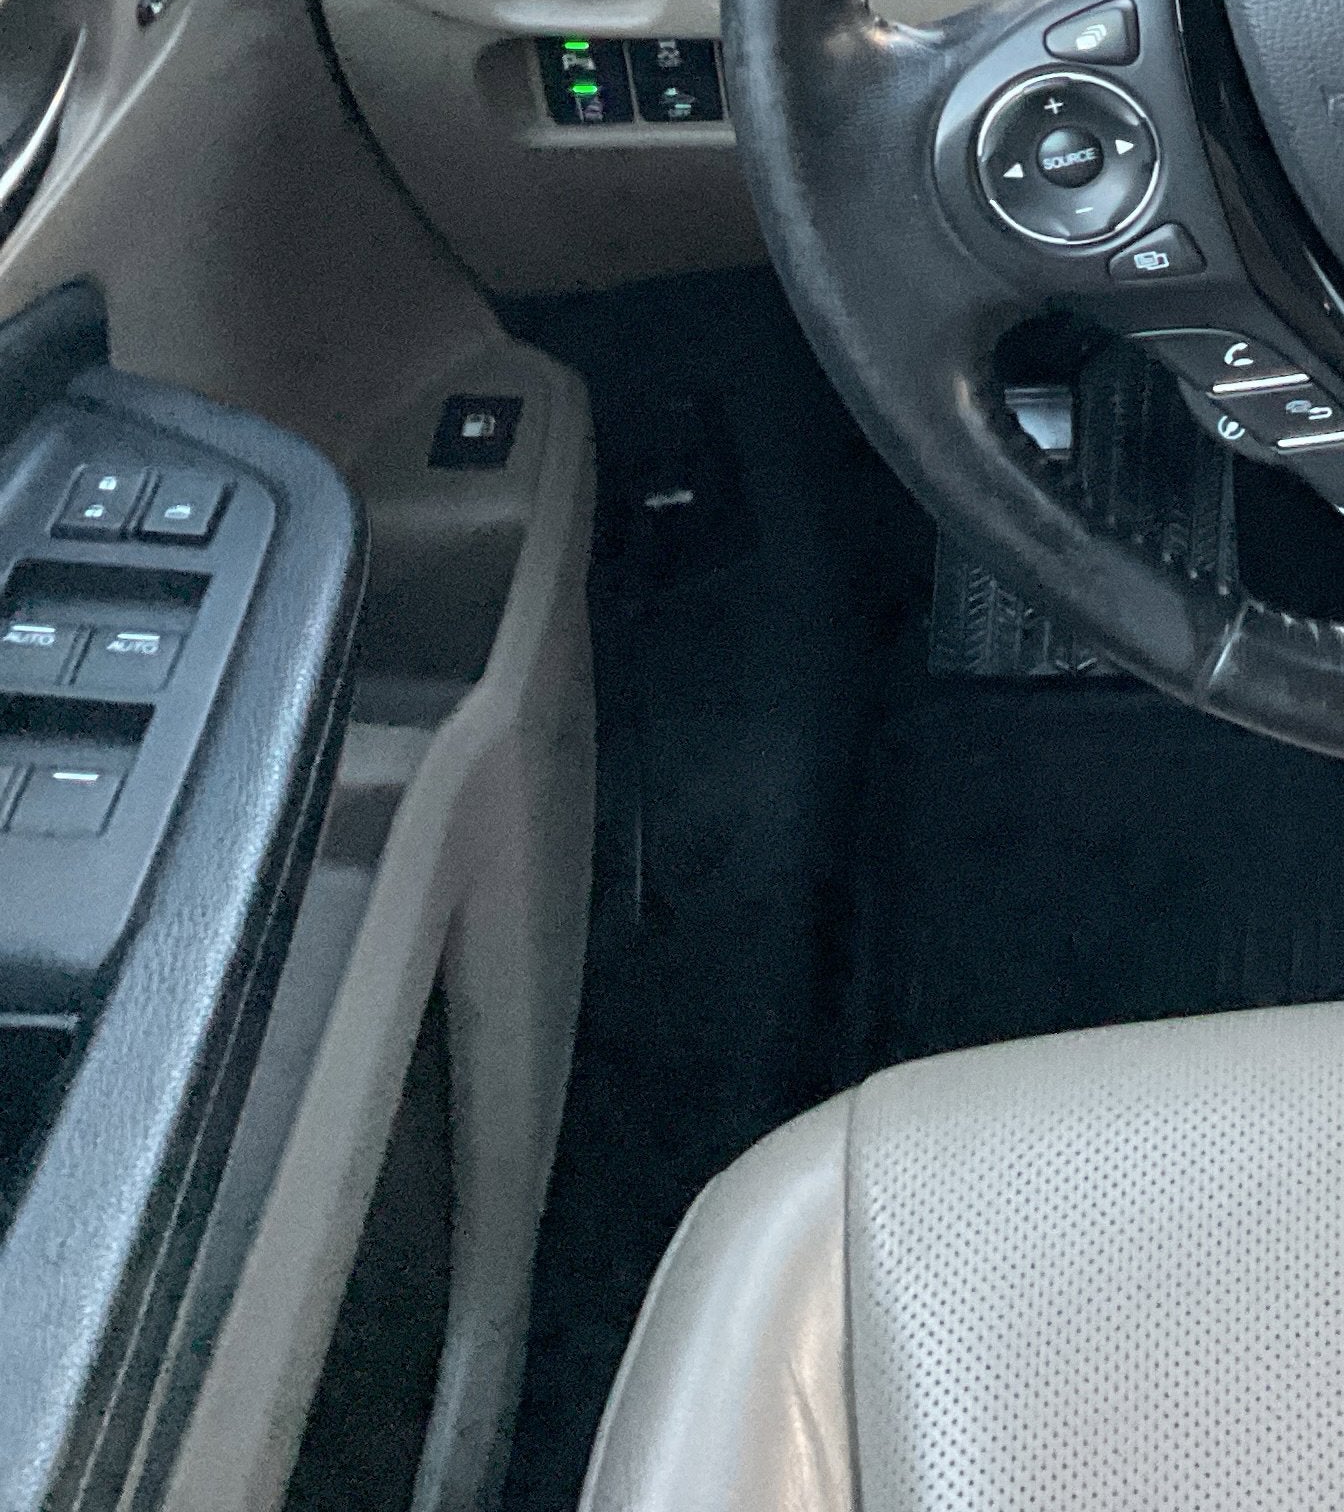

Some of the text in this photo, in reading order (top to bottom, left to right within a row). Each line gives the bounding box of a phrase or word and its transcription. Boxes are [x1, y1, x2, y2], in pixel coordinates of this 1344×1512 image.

[1042, 146, 1098, 172] SOURCE
[3, 631, 56, 646] AUTO
[106, 639, 160, 655] AUTO
